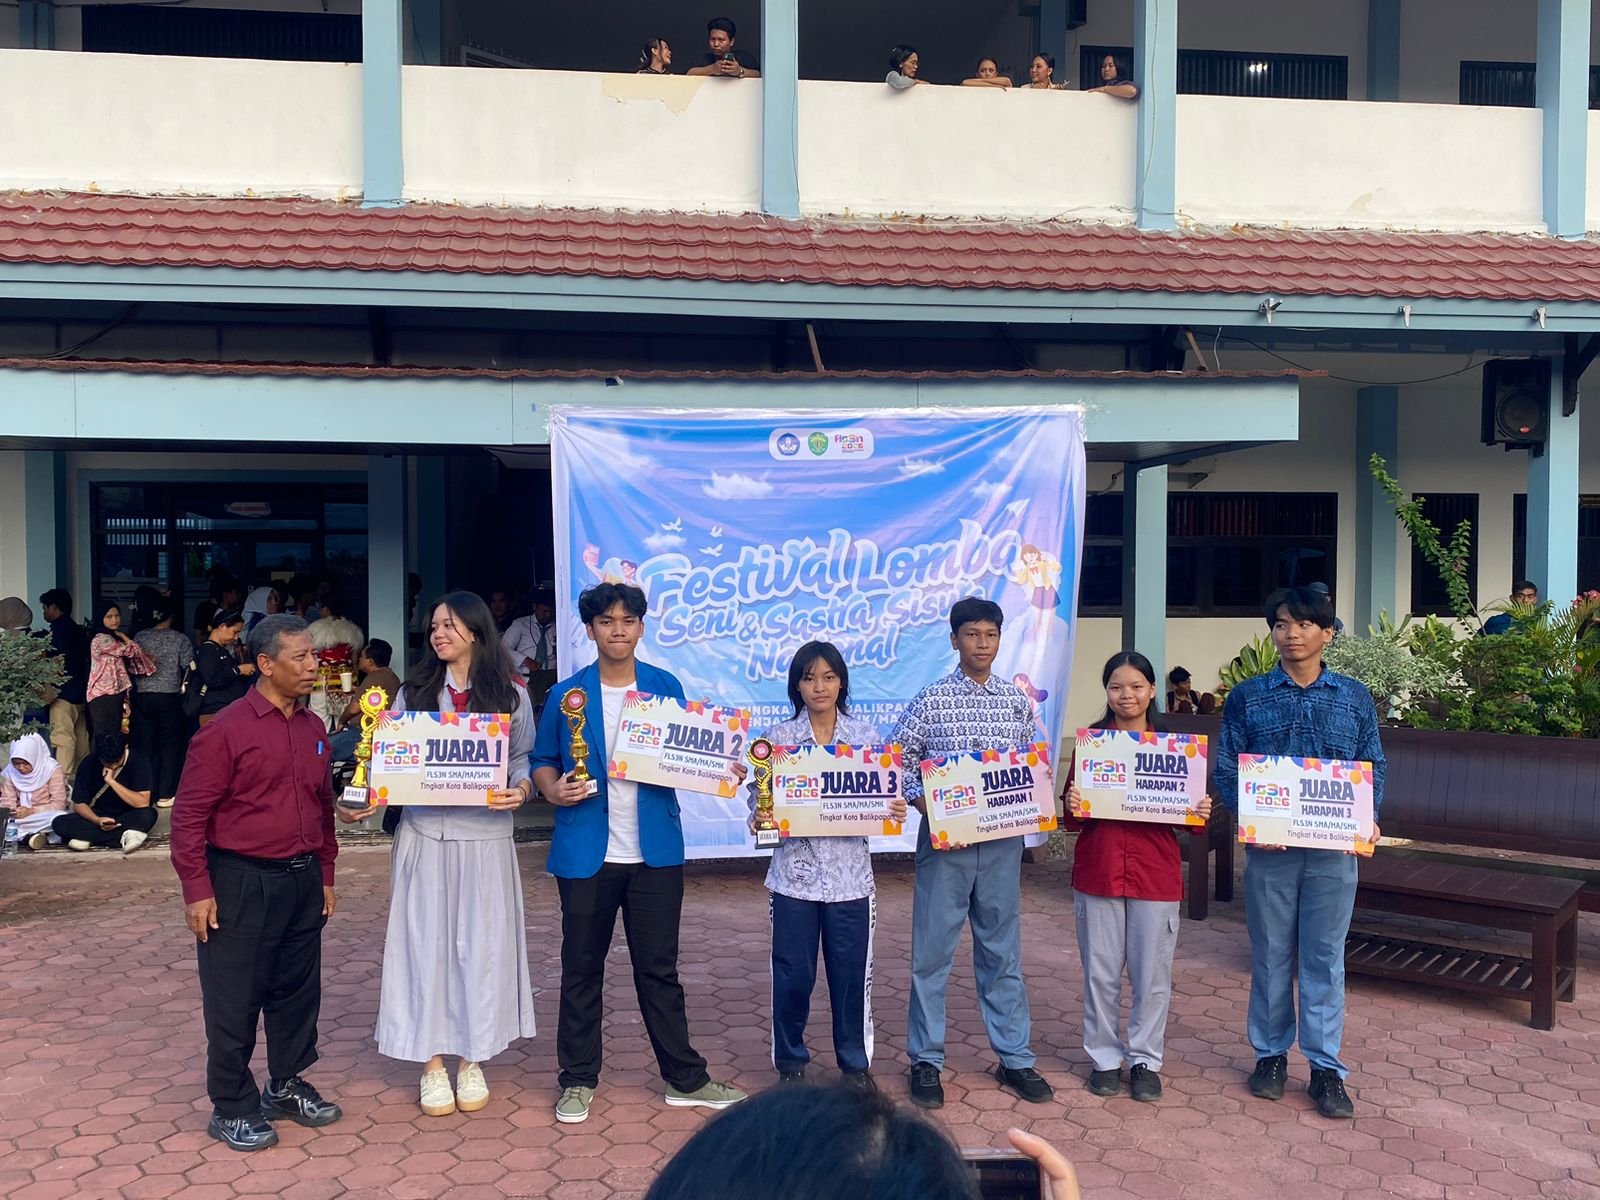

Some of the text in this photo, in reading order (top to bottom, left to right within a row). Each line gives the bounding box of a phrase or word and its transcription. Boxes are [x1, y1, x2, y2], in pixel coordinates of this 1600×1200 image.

[636, 528, 851, 614] Festival
[853, 518, 1022, 596] Lomba
[656, 602, 739, 647] Seni
[736, 610, 762, 646] &
[760, 592, 876, 643] Sastra
[629, 734, 660, 746] 2026
[664, 723, 743, 757] JUARA 2
[425, 739, 502, 762] JUARA 1
[384, 755, 420, 765] 2026
[664, 753, 683, 763] FLS3N
[1134, 753, 1189, 775] JUARA
[426, 771, 446, 779] FLS3N
[658, 763, 733, 782] Tingkat Kota Balikpapan
[981, 766, 1034, 792] JUARA
[1093, 774, 1126, 783] 2026
[420, 782, 500, 791] Tingkat Kota Balikpapan
[821, 771, 897, 794] JUARA 3
[1136, 779, 1177, 791] HARAPAN
[1179, 782, 1185, 792] 2
[786, 788, 819, 798] 2026
[1299, 779, 1355, 801] JUARA
[944, 796, 977, 810] 2026
[987, 794, 1027, 808] HARAPAN
[1127, 794, 1147, 802] FLS3N
[1256, 796, 1290, 806] 2026
[823, 801, 842, 809] FLS3N
[1121, 804, 1200, 816] Tingkat Kota Balikpapan
[1301, 804, 1344, 818] HARAPAN
[1347, 808, 1352, 818] 3
[819, 814, 843, 823] Tingkat
[844, 813, 858, 821] Kota
[979, 813, 998, 823] FLS3N
[1293, 819, 1313, 827] FLS3N
[976, 816, 1050, 834] Tingkat Kota Balikpapan
[1288, 830, 1366, 843] Tingkat Kota Balikpapan
